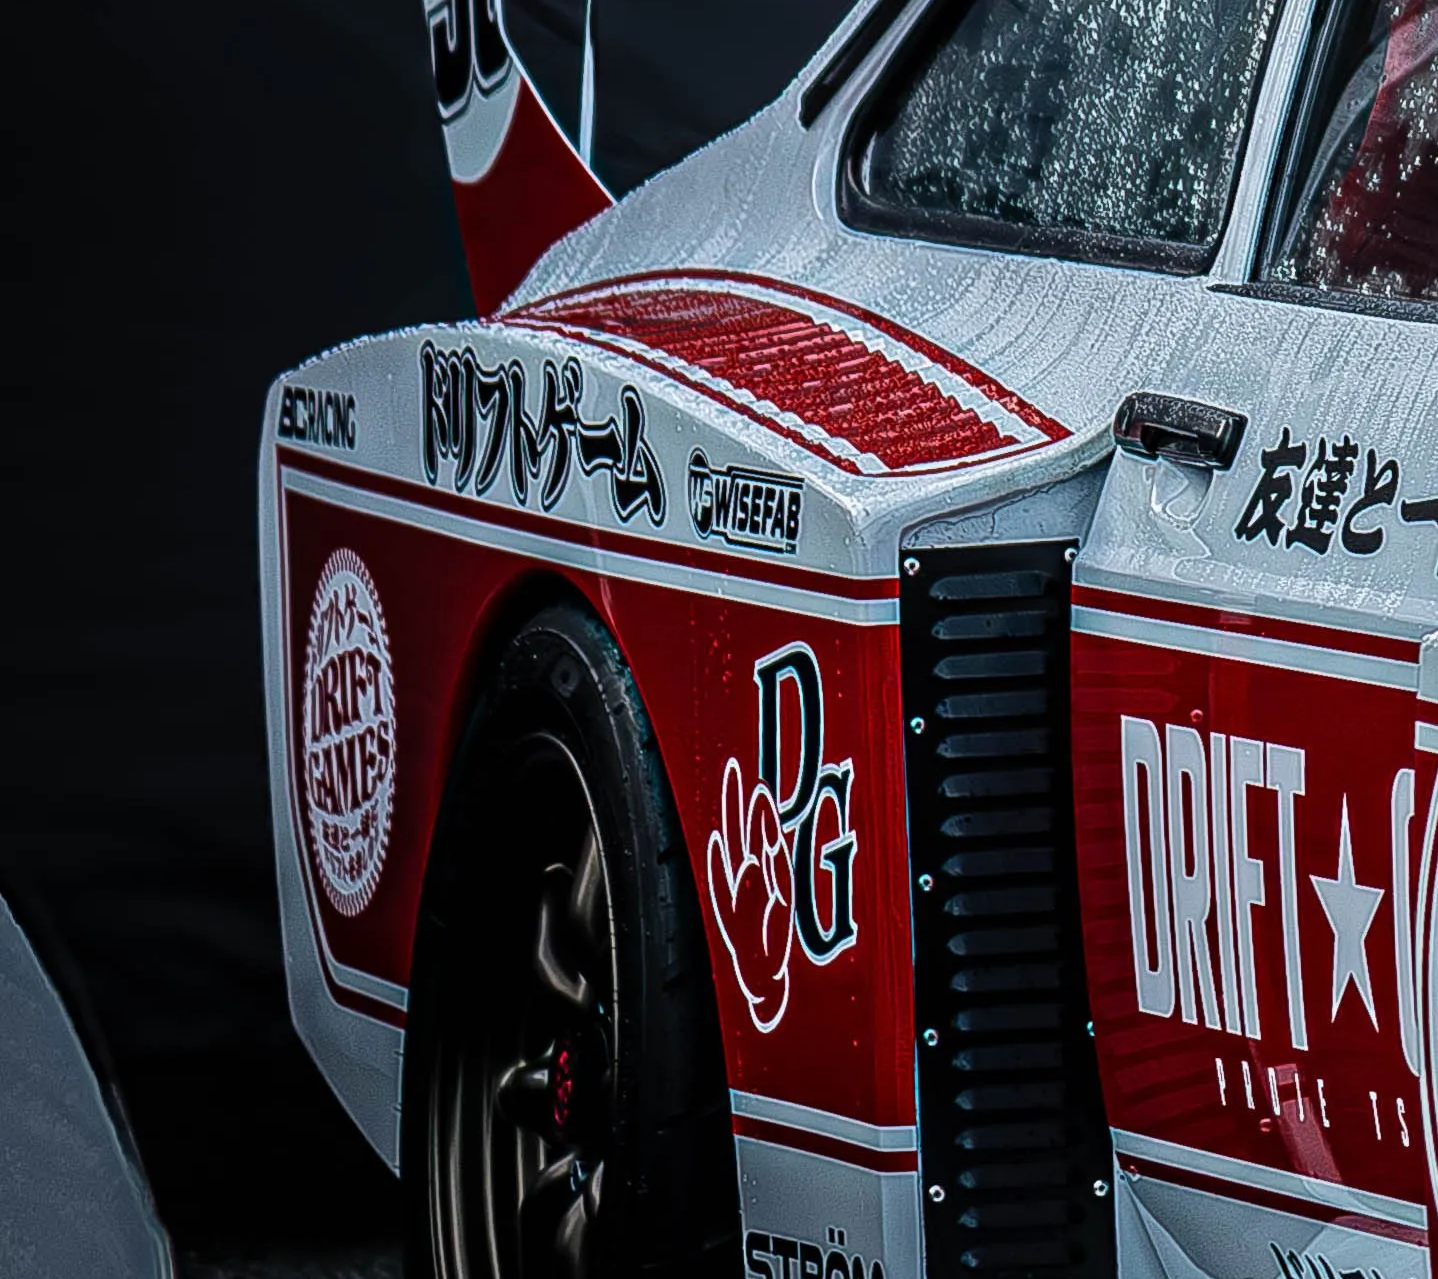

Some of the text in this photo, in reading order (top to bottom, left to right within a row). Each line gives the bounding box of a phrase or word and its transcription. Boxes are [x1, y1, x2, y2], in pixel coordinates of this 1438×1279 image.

[420, 339, 666, 528] ドリフトゲーム
[714, 477, 802, 542] WISEFAB
[311, 646, 385, 744] DRIFT
[308, 722, 390, 817] GAMES
[1119, 714, 1310, 1052] DRIFT
